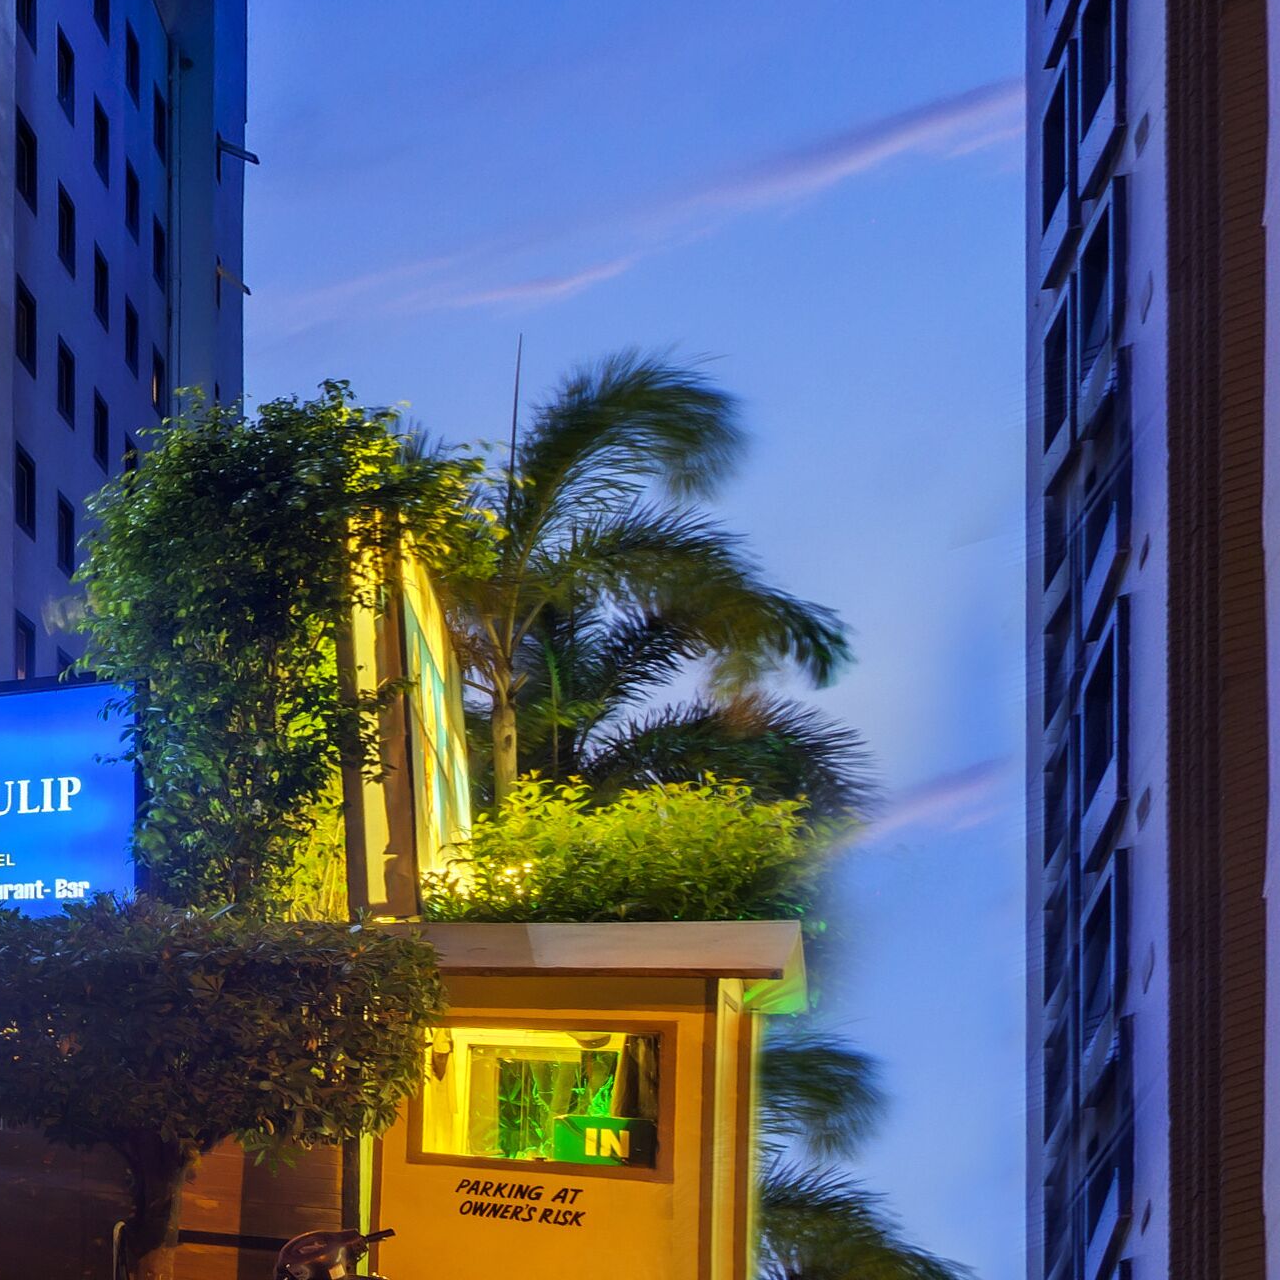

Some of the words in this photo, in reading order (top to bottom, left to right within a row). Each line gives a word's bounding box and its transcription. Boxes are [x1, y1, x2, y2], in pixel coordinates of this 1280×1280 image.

[55, 878, 90, 899] Bar
[584, 1127, 630, 1158] IN
[455, 1179, 544, 1200] PARKING
[551, 1188, 584, 1204] AT
[459, 1200, 537, 1222] OWNER'S
[538, 1208, 586, 1226] RISK
